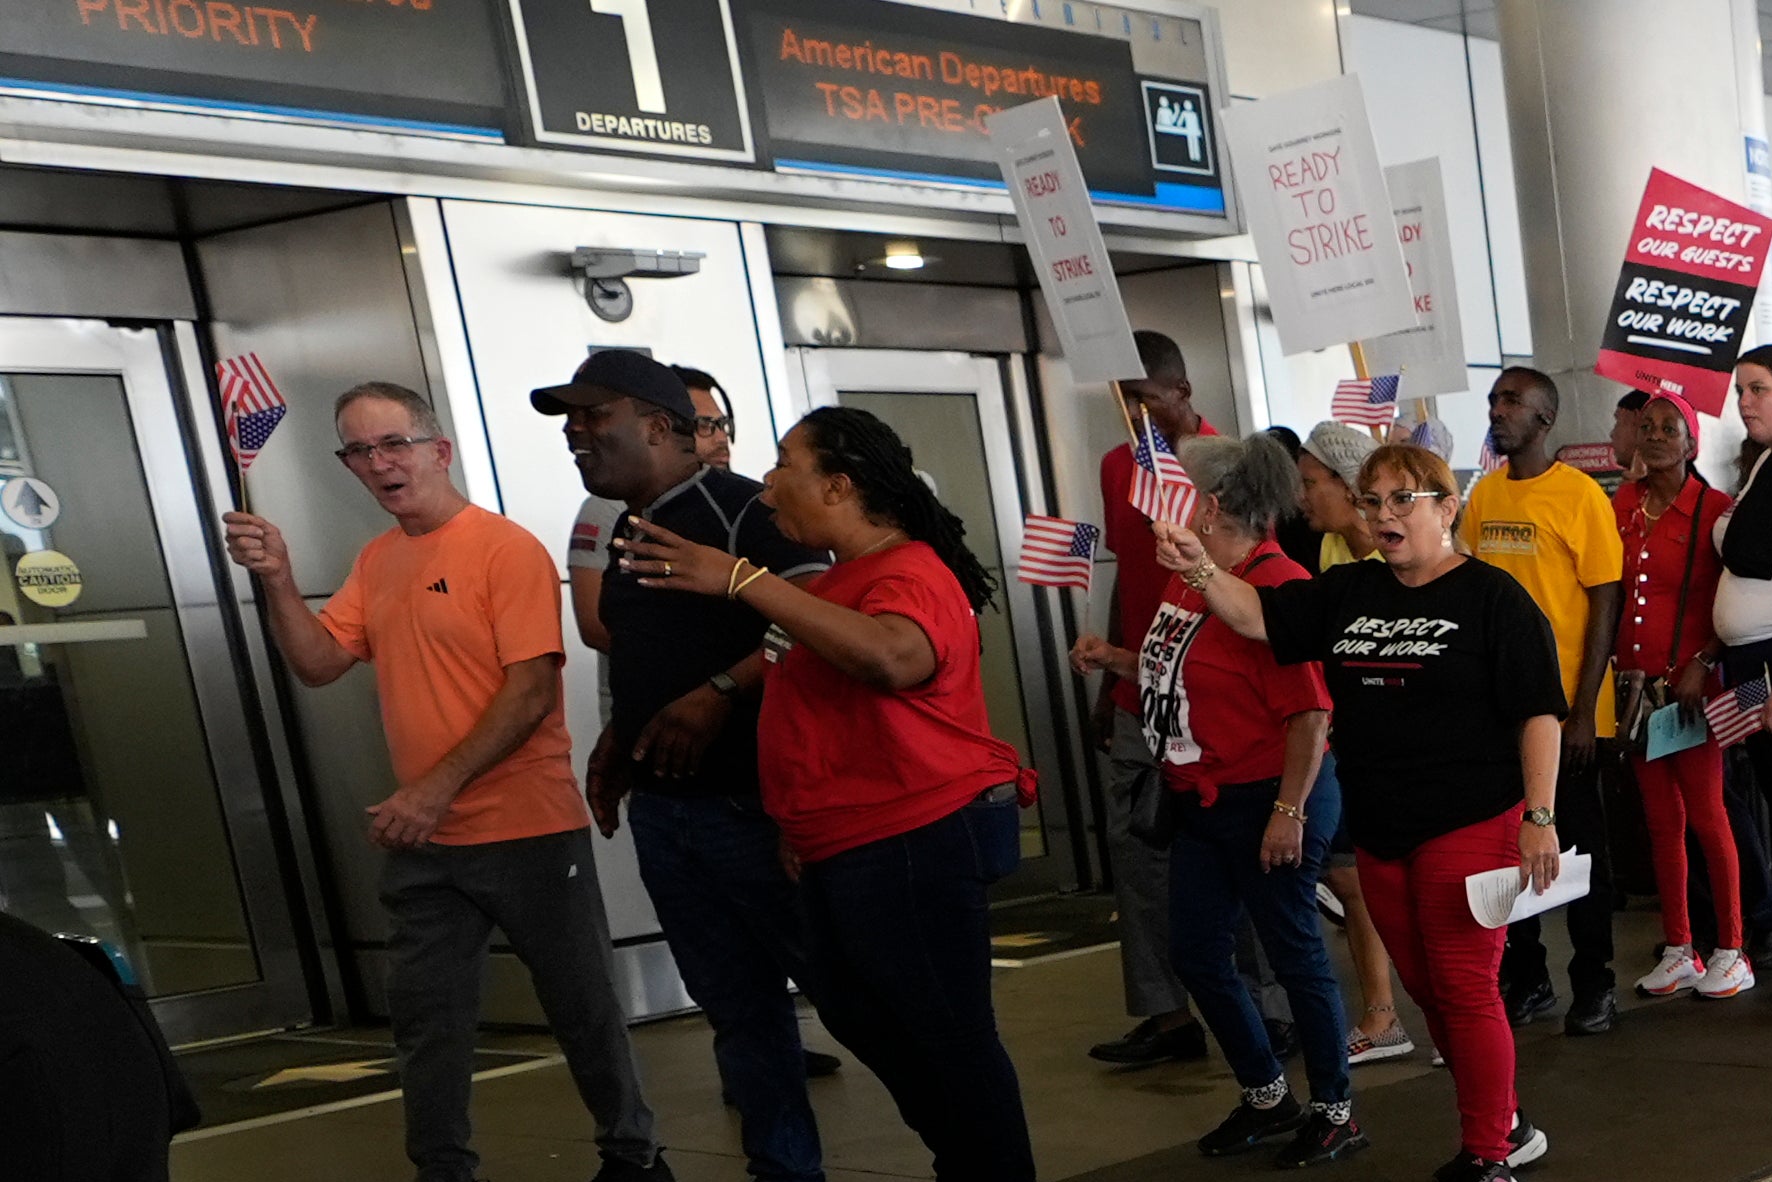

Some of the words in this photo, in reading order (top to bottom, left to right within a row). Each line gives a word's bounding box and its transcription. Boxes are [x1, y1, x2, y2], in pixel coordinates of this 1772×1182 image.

[78, 0, 318, 52] PRIORITY
[590, 0, 667, 114] 1
[780, 28, 933, 81] American
[938, 51, 1101, 105] Departures
[575, 111, 713, 144] DEPARTURES
[815, 82, 890, 123] TSA
[893, 92, 1086, 148] PRE-CK
[1023, 169, 1063, 198] READY
[1267, 146, 1342, 191] READY
[1291, 188, 1335, 217] TO
[1047, 216, 1068, 237] TO
[1287, 213, 1374, 266] STRIKE
[1645, 204, 1762, 248] RESPECT
[1051, 254, 1094, 282] STRIKE
[1636, 236, 1680, 258] OUR
[1680, 245, 1754, 272] GUESTS
[1625, 276, 1741, 321] RESPECT
[1616, 309, 1664, 333] OUR
[1666, 316, 1735, 343] WORK
[18, 573, 82, 586] CAUTION
[37, 586, 68, 595] DOOR
[1343, 616, 1459, 638] RESPECT
[1332, 639, 1378, 655] OUR
[1378, 640, 1449, 656] WORK
